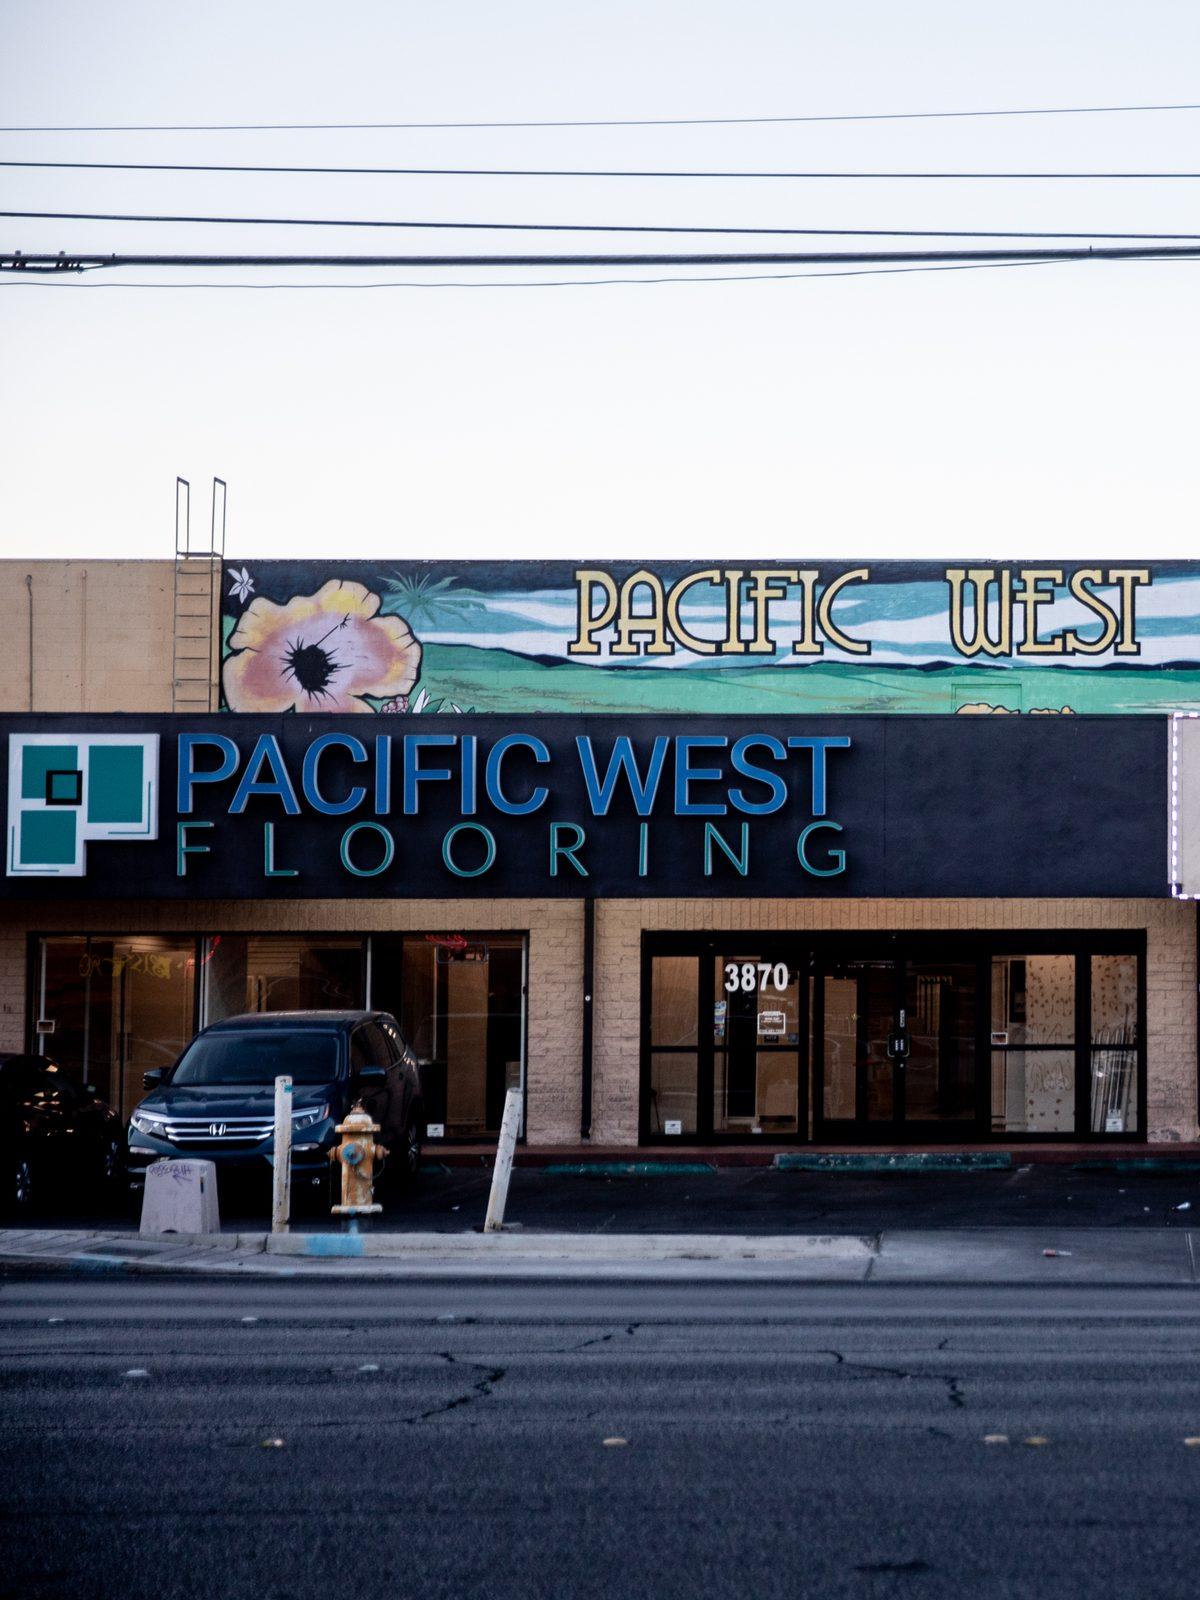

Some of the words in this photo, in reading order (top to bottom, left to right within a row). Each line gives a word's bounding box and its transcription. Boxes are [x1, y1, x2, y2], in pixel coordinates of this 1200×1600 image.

[567, 567, 872, 656] PACIFIC
[943, 567, 1150, 658] WEST
[177, 733, 550, 815] PACIFIC
[576, 733, 851, 815] WEST
[177, 822, 847, 877] FLOORING
[725, 962, 789, 992] 3870
